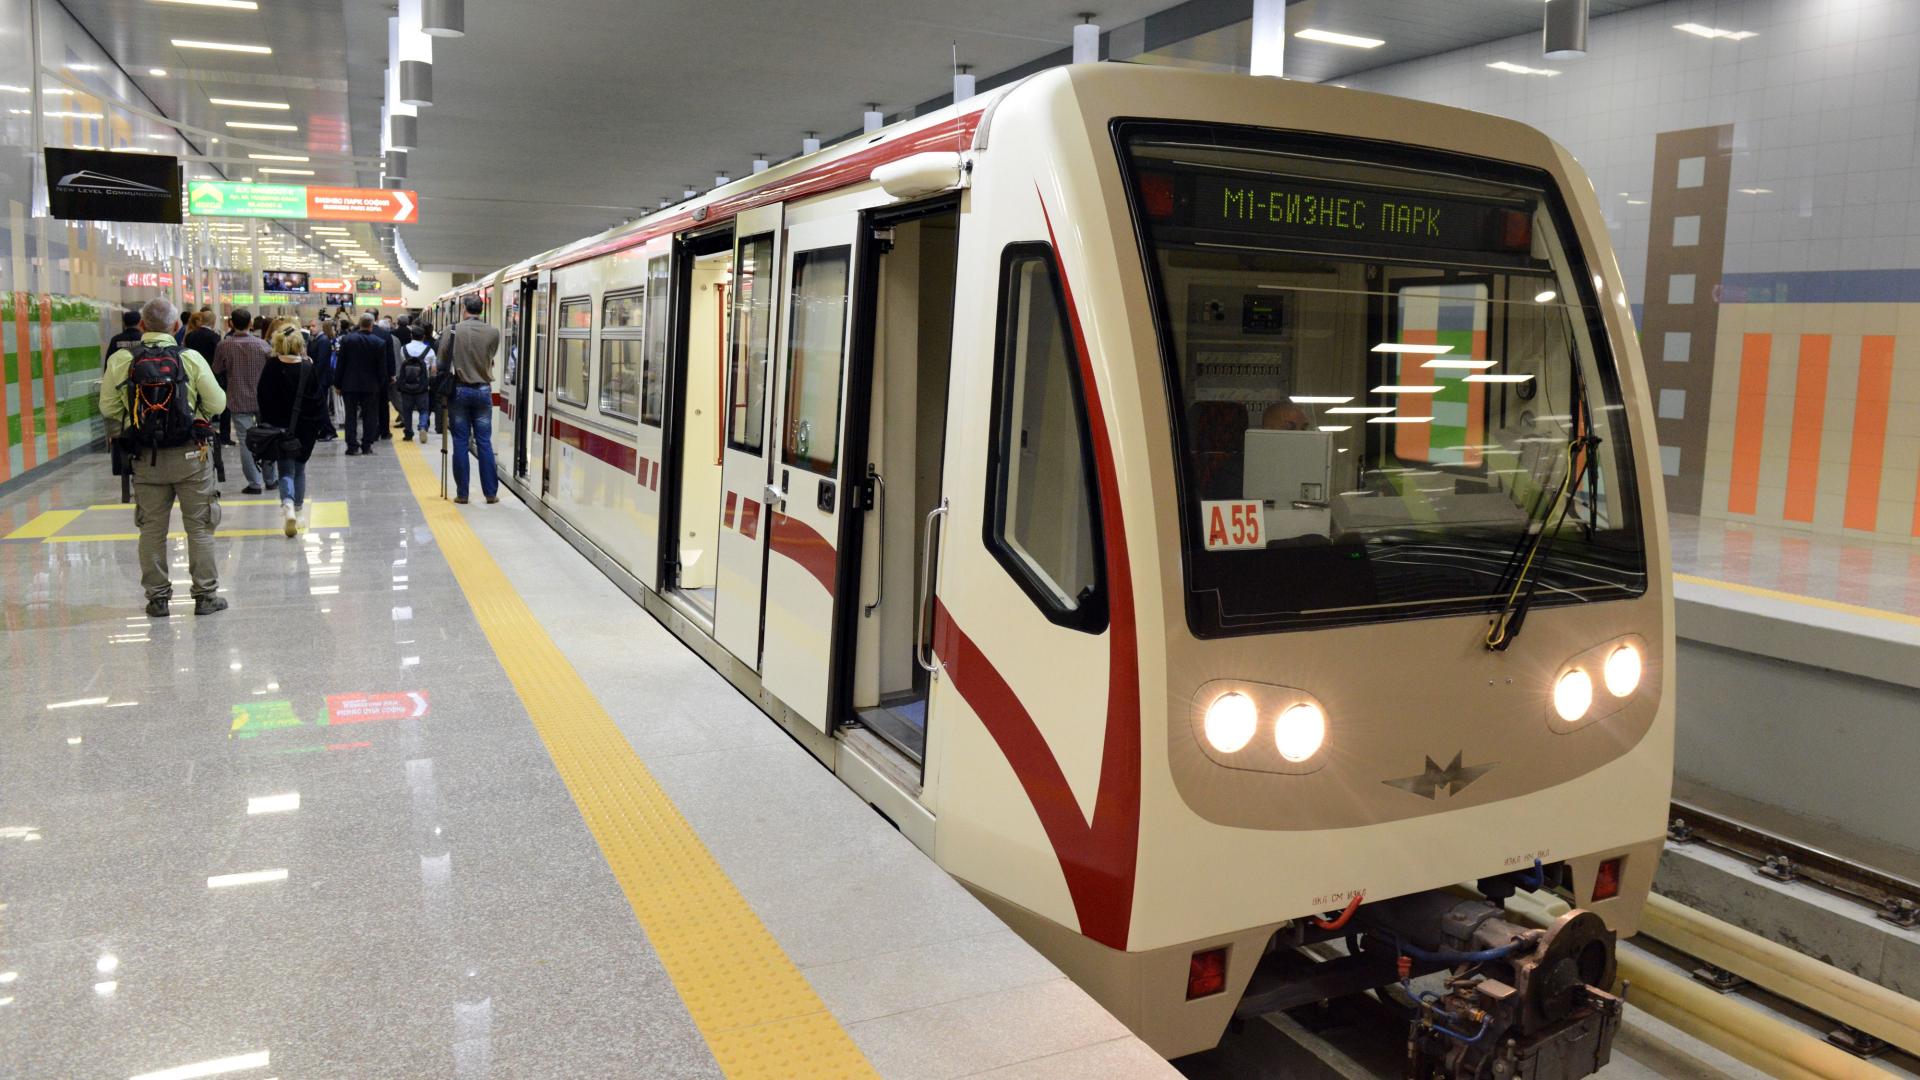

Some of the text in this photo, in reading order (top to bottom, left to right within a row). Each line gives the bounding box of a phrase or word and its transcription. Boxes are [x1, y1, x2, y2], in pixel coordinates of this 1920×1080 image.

[106, 189, 172, 199] COMMUNICATION
[1223, 187, 1441, 238] М1-БИЗНЕС ПАРК
